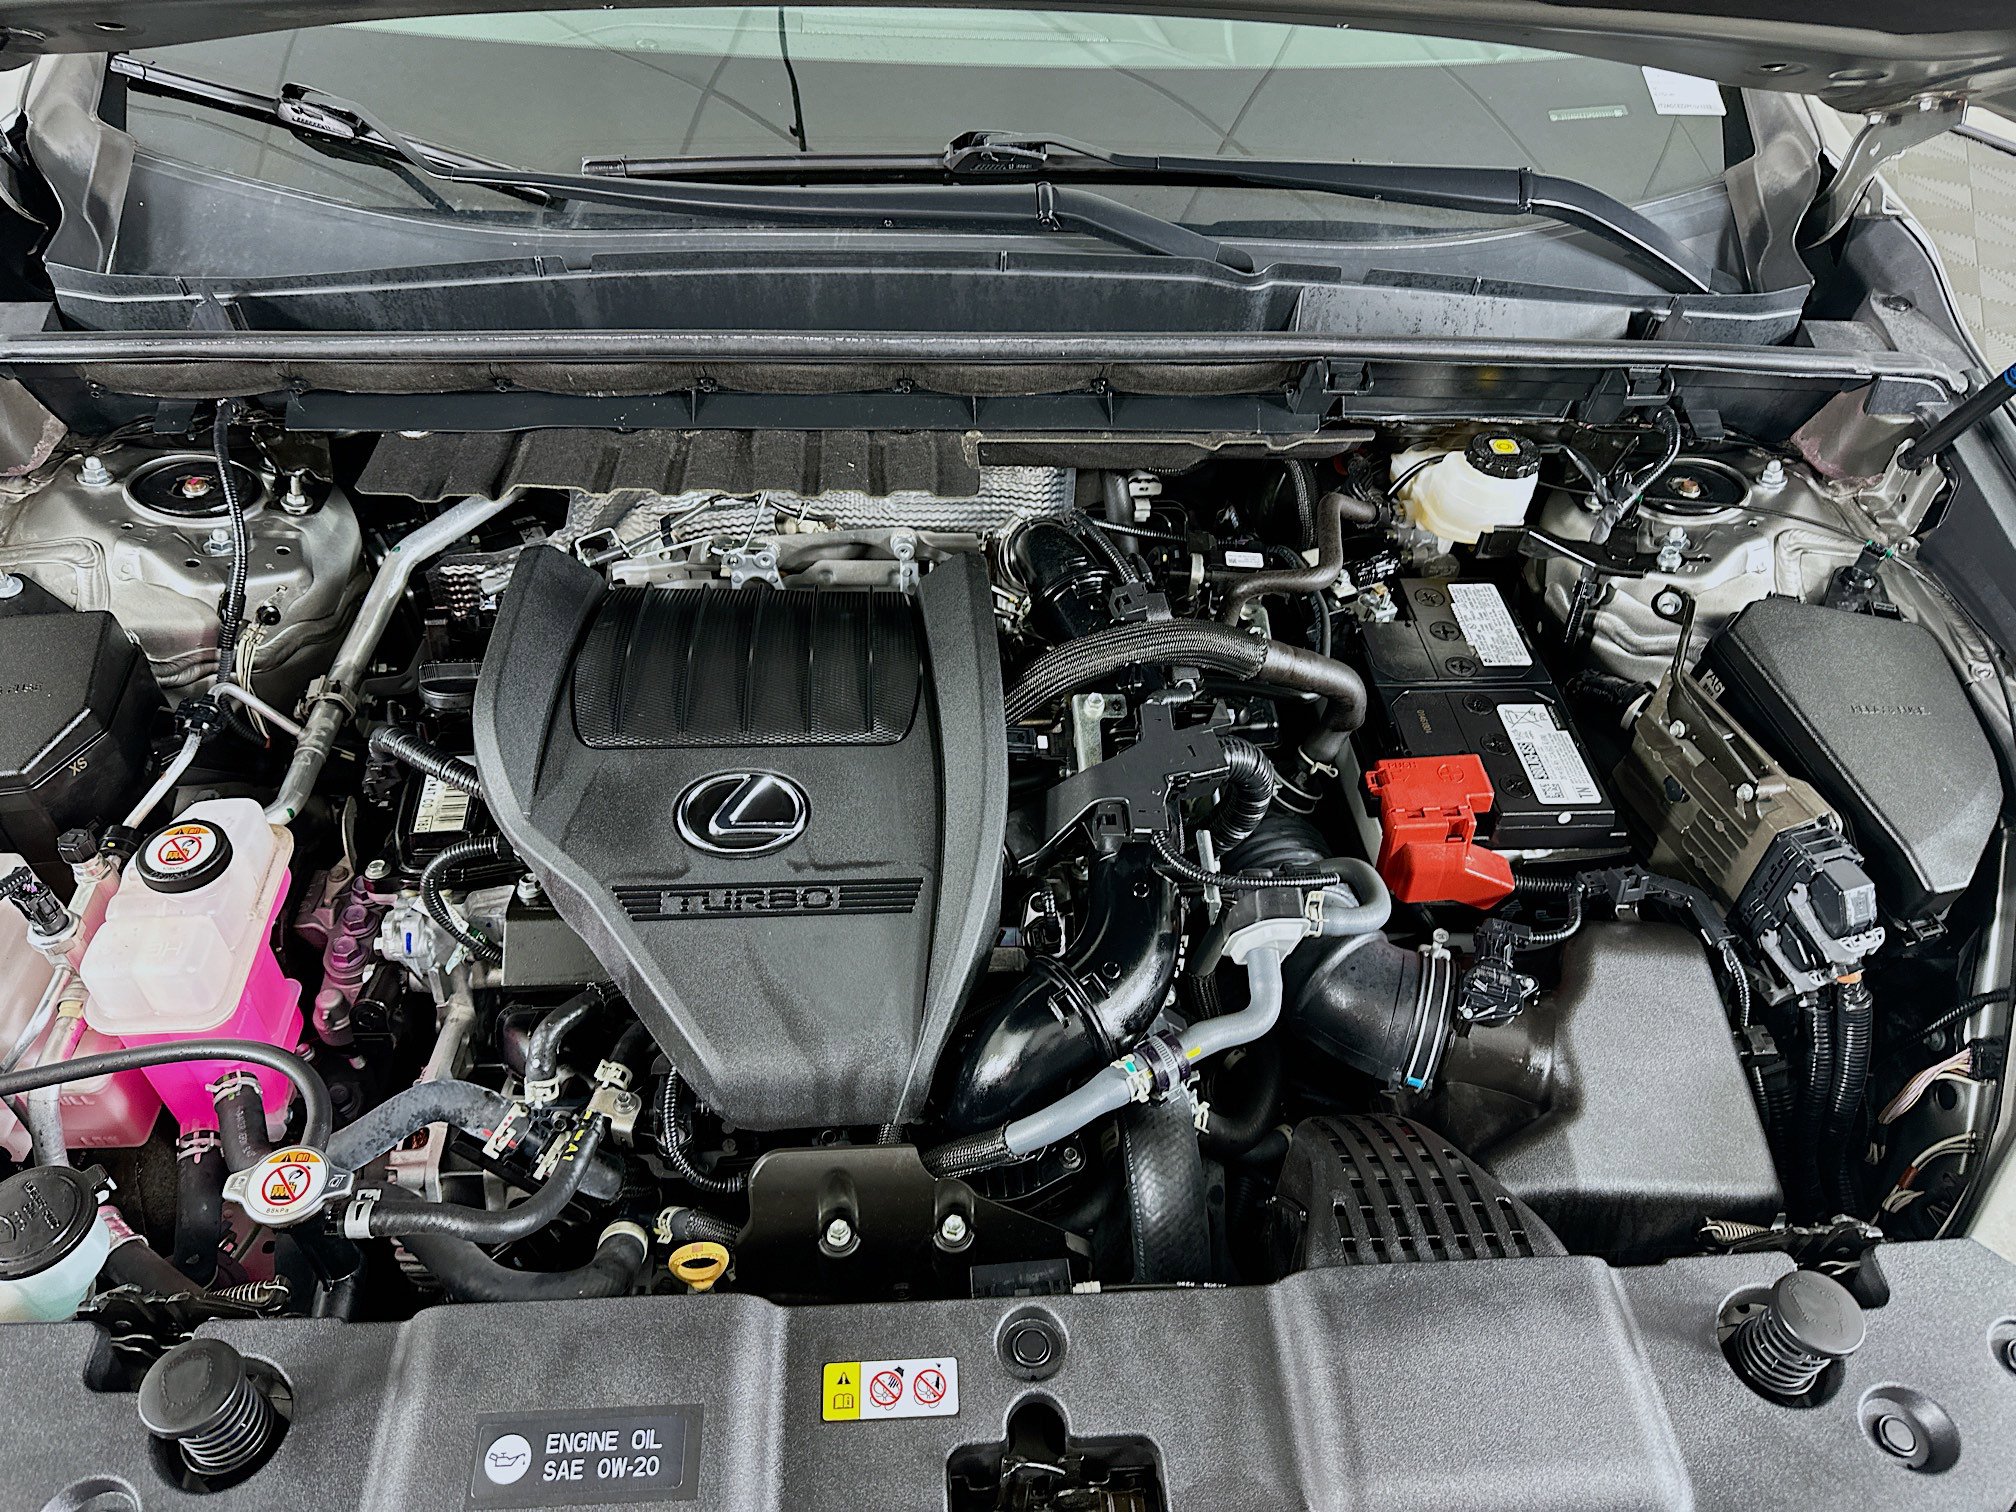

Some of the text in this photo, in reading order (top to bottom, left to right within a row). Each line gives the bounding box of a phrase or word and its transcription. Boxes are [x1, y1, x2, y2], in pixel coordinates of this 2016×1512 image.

[68, 757, 88, 777] XS
[667, 887, 835, 913] TURBO
[545, 1428, 663, 1454] ENGINE OIL
[542, 1455, 661, 1481] SAE 0W-20
